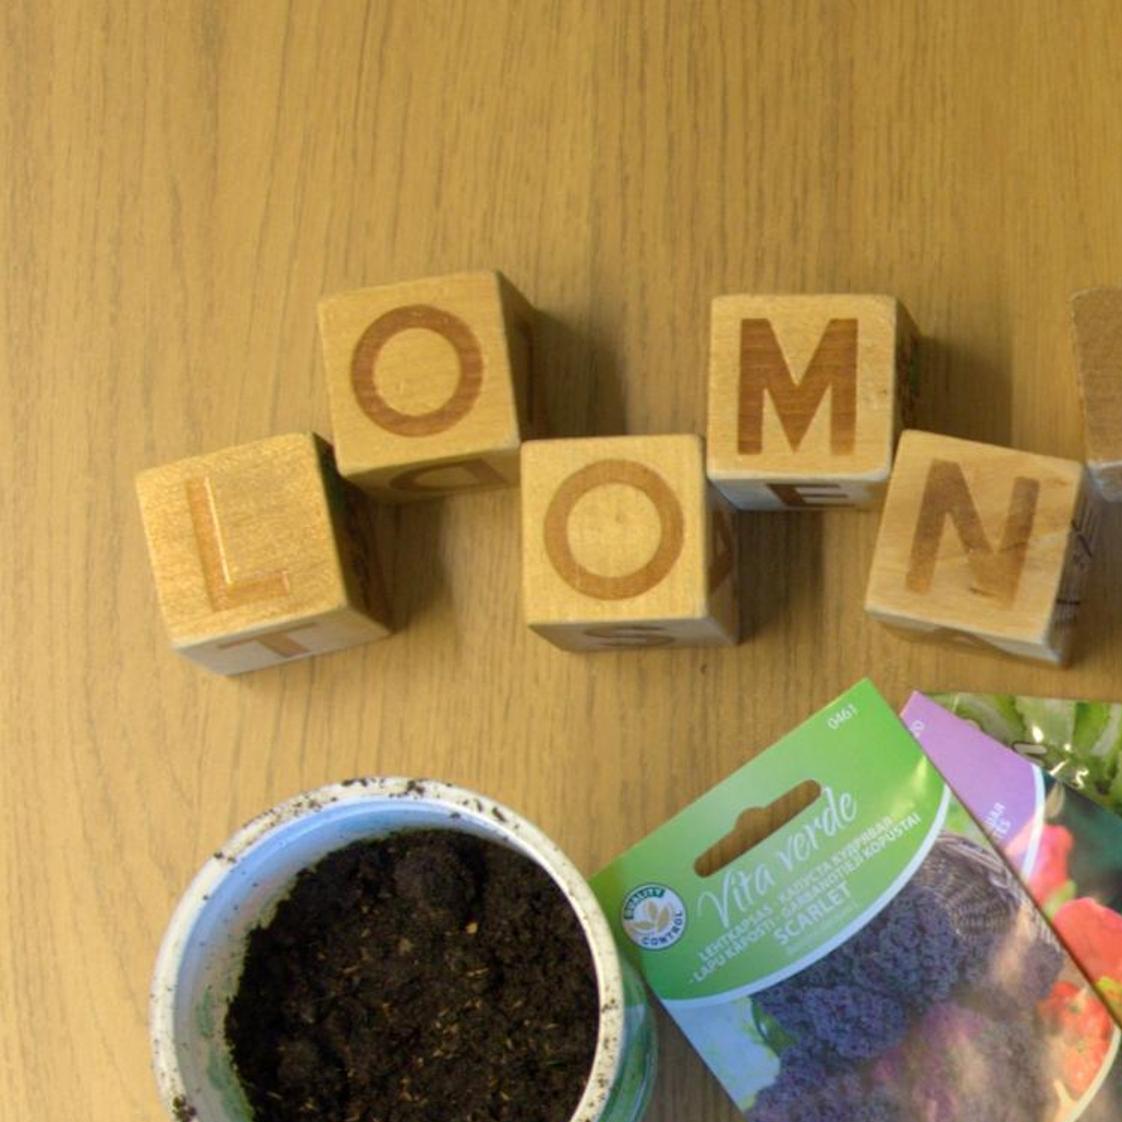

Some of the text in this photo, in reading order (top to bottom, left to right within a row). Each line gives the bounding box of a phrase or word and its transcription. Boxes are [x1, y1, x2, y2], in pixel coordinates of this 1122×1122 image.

[351, 304, 483, 437] O
[737, 318, 859, 455] M
[186, 476, 289, 612] L
[544, 459, 684, 600] O
[905, 459, 1040, 610] N
[827, 703, 858, 731] 0461
[699, 786, 857, 929] Vita verde
[772, 880, 854, 946] SCARLET
